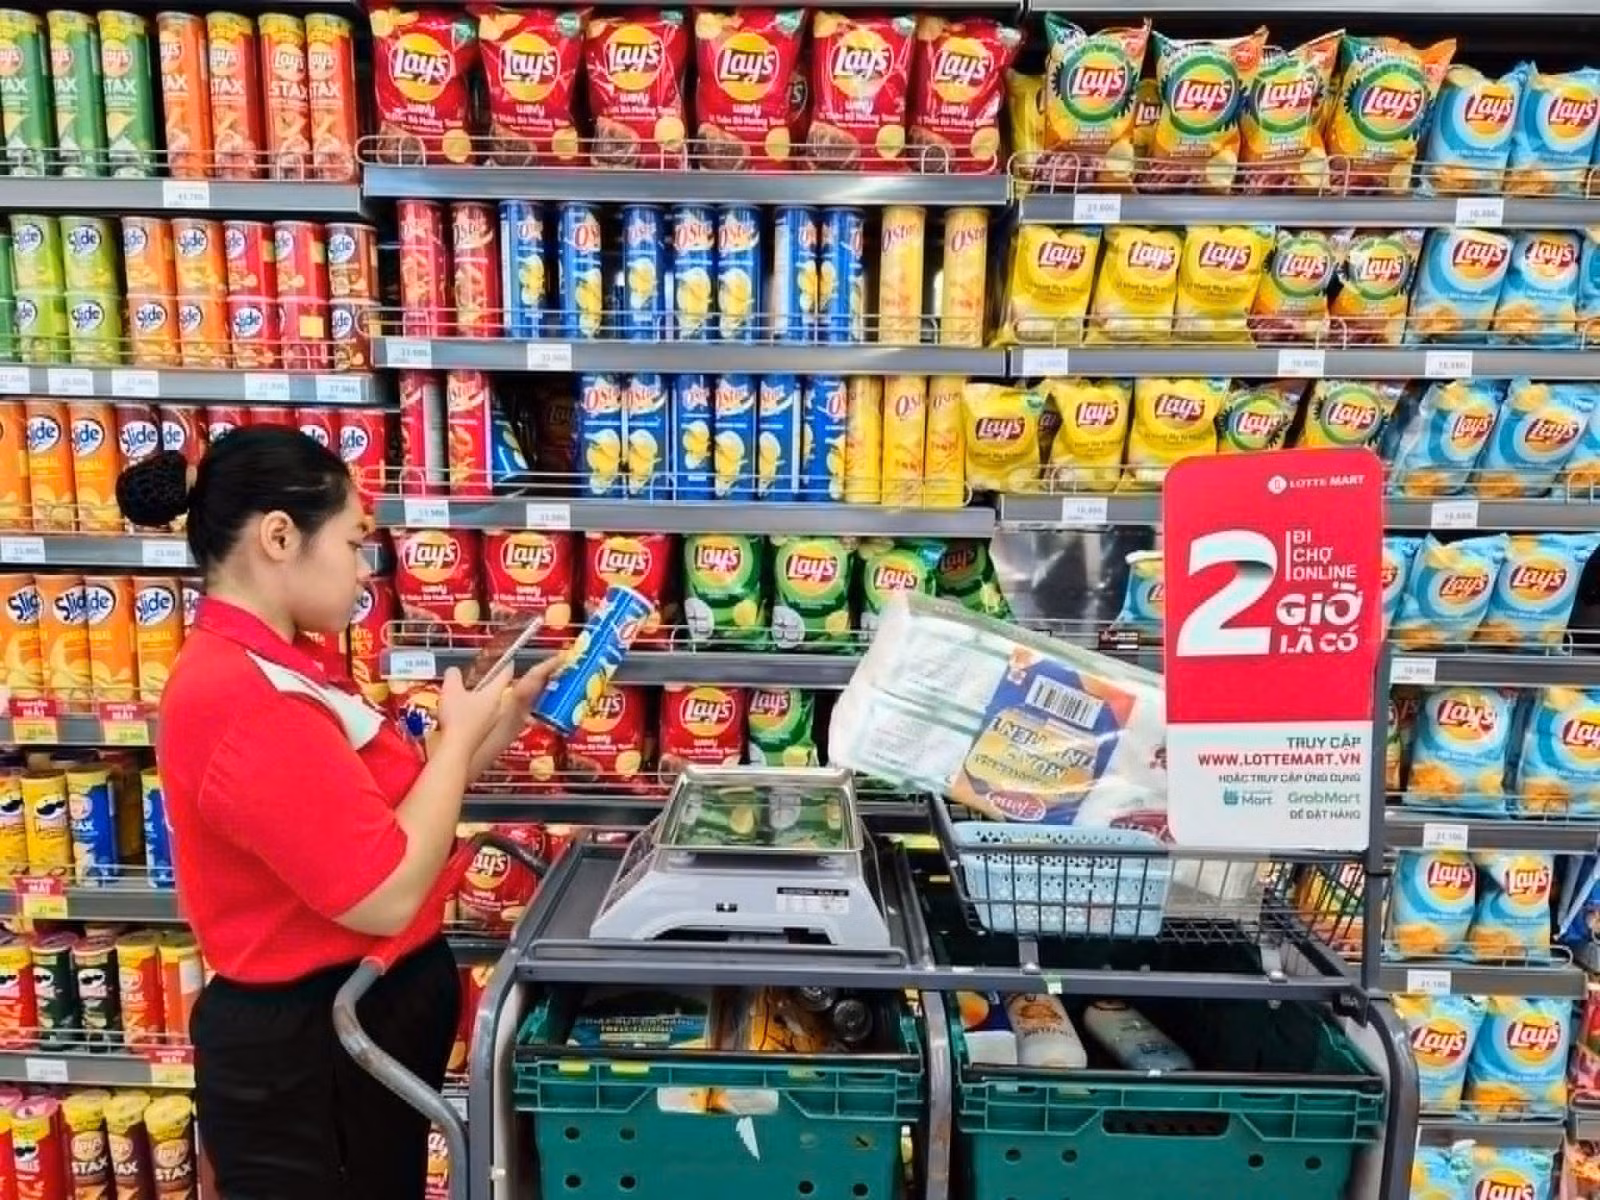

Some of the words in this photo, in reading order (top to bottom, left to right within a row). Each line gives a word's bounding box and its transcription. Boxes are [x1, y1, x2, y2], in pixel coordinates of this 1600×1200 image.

[1290, 477, 1327, 488] LOTTE
[1329, 474, 1365, 486] MART
[1293, 546, 1334, 565] CHỢ
[1293, 563, 1357, 581] ONLINE
[1176, 529, 1278, 656] 2
[1321, 624, 1359, 653] CÓ
[1287, 736, 1326, 750] TRUY
[1197, 753, 1361, 767] WWW.LOTTEMART.VN
[1242, 793, 1273, 807] Mart
[1287, 790, 1361, 806] GrabMart
